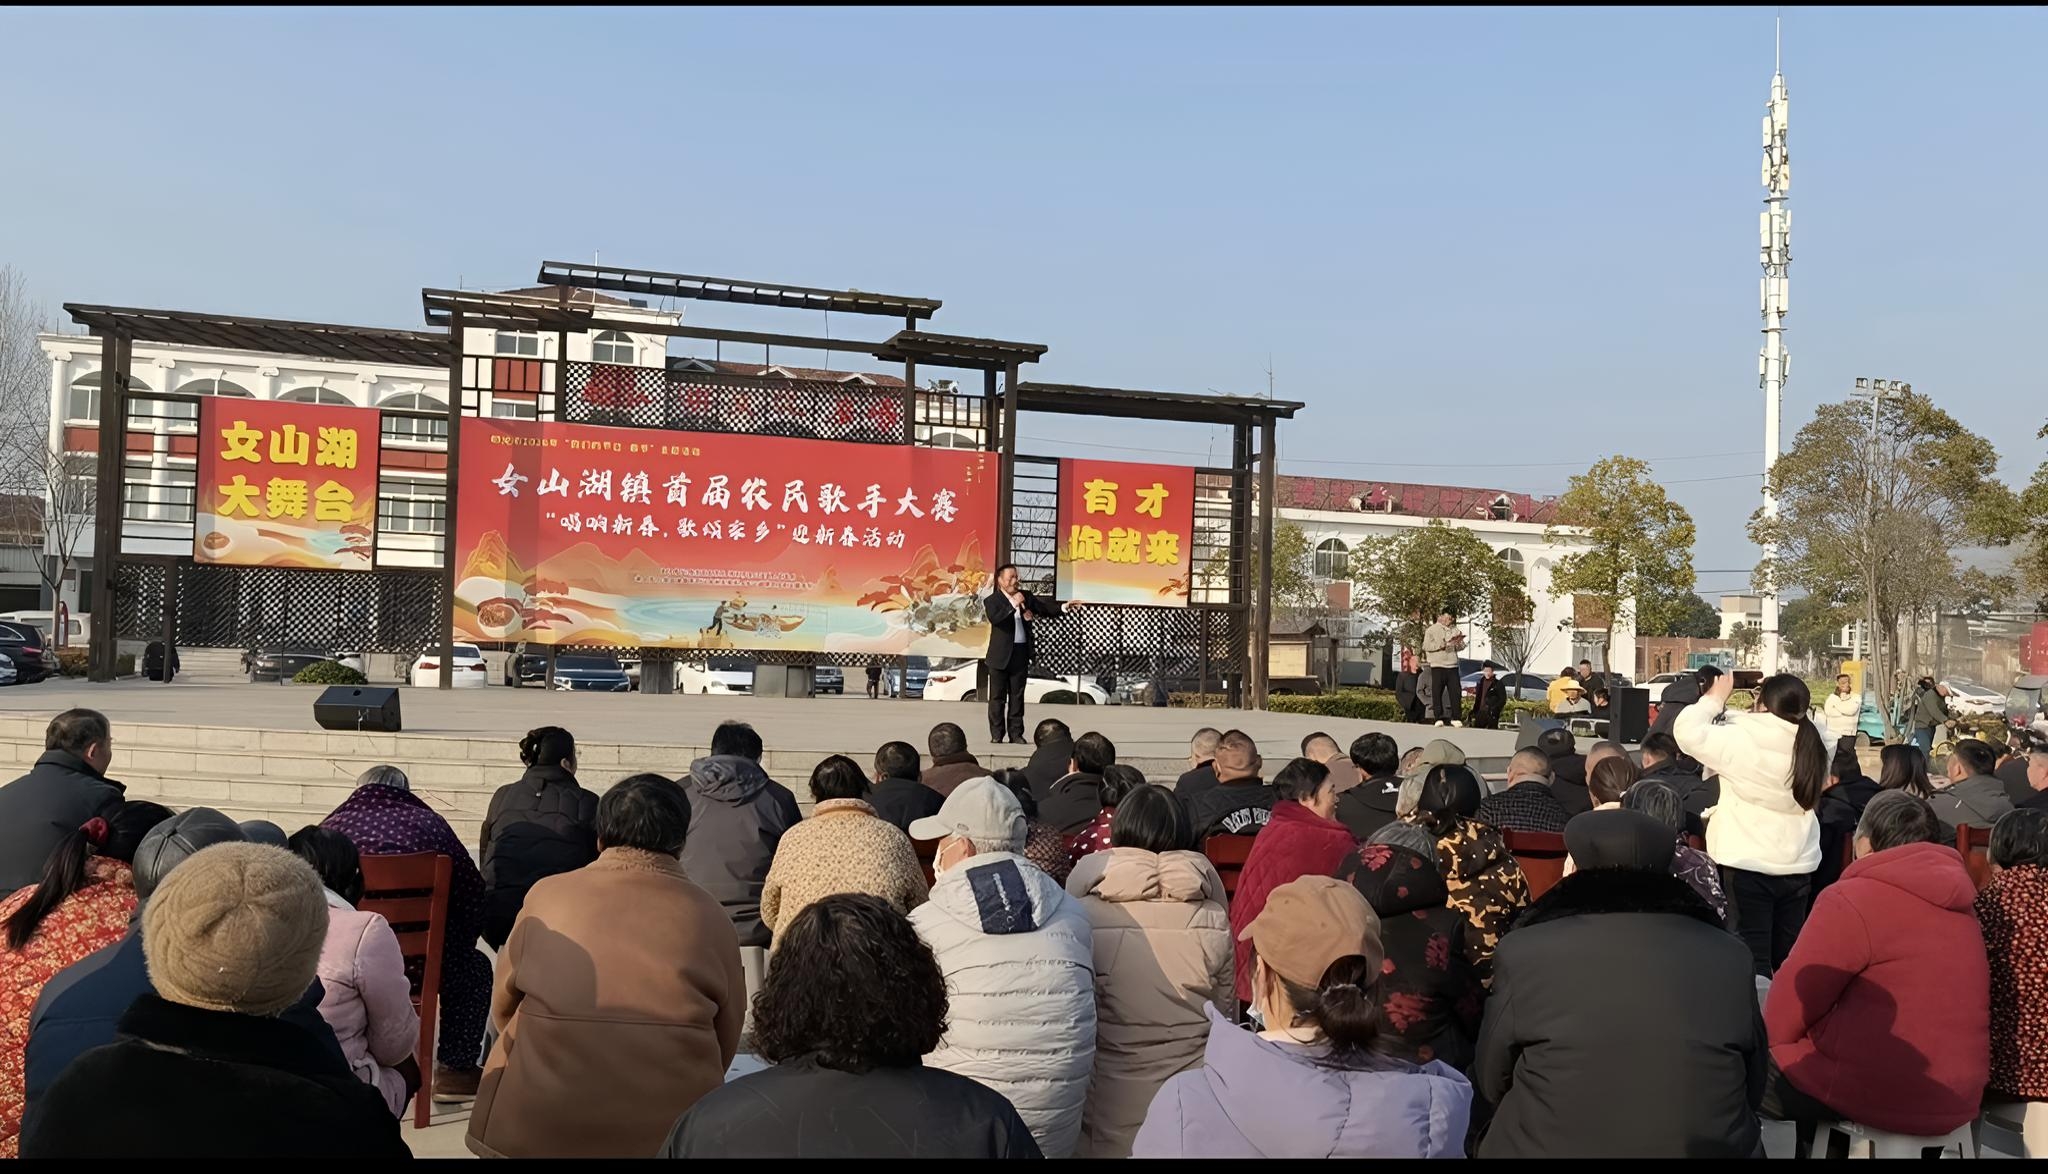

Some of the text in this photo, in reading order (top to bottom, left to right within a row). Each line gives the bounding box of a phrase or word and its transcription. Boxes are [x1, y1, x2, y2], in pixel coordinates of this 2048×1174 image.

[220, 420, 358, 469] 女山湖
[216, 474, 355, 523] 大舞台
[491, 462, 959, 523] 女山湖镇首届农民歌手大赛
[1083, 479, 1169, 518] 有才
[1058, 525, 1180, 567] 你就来
